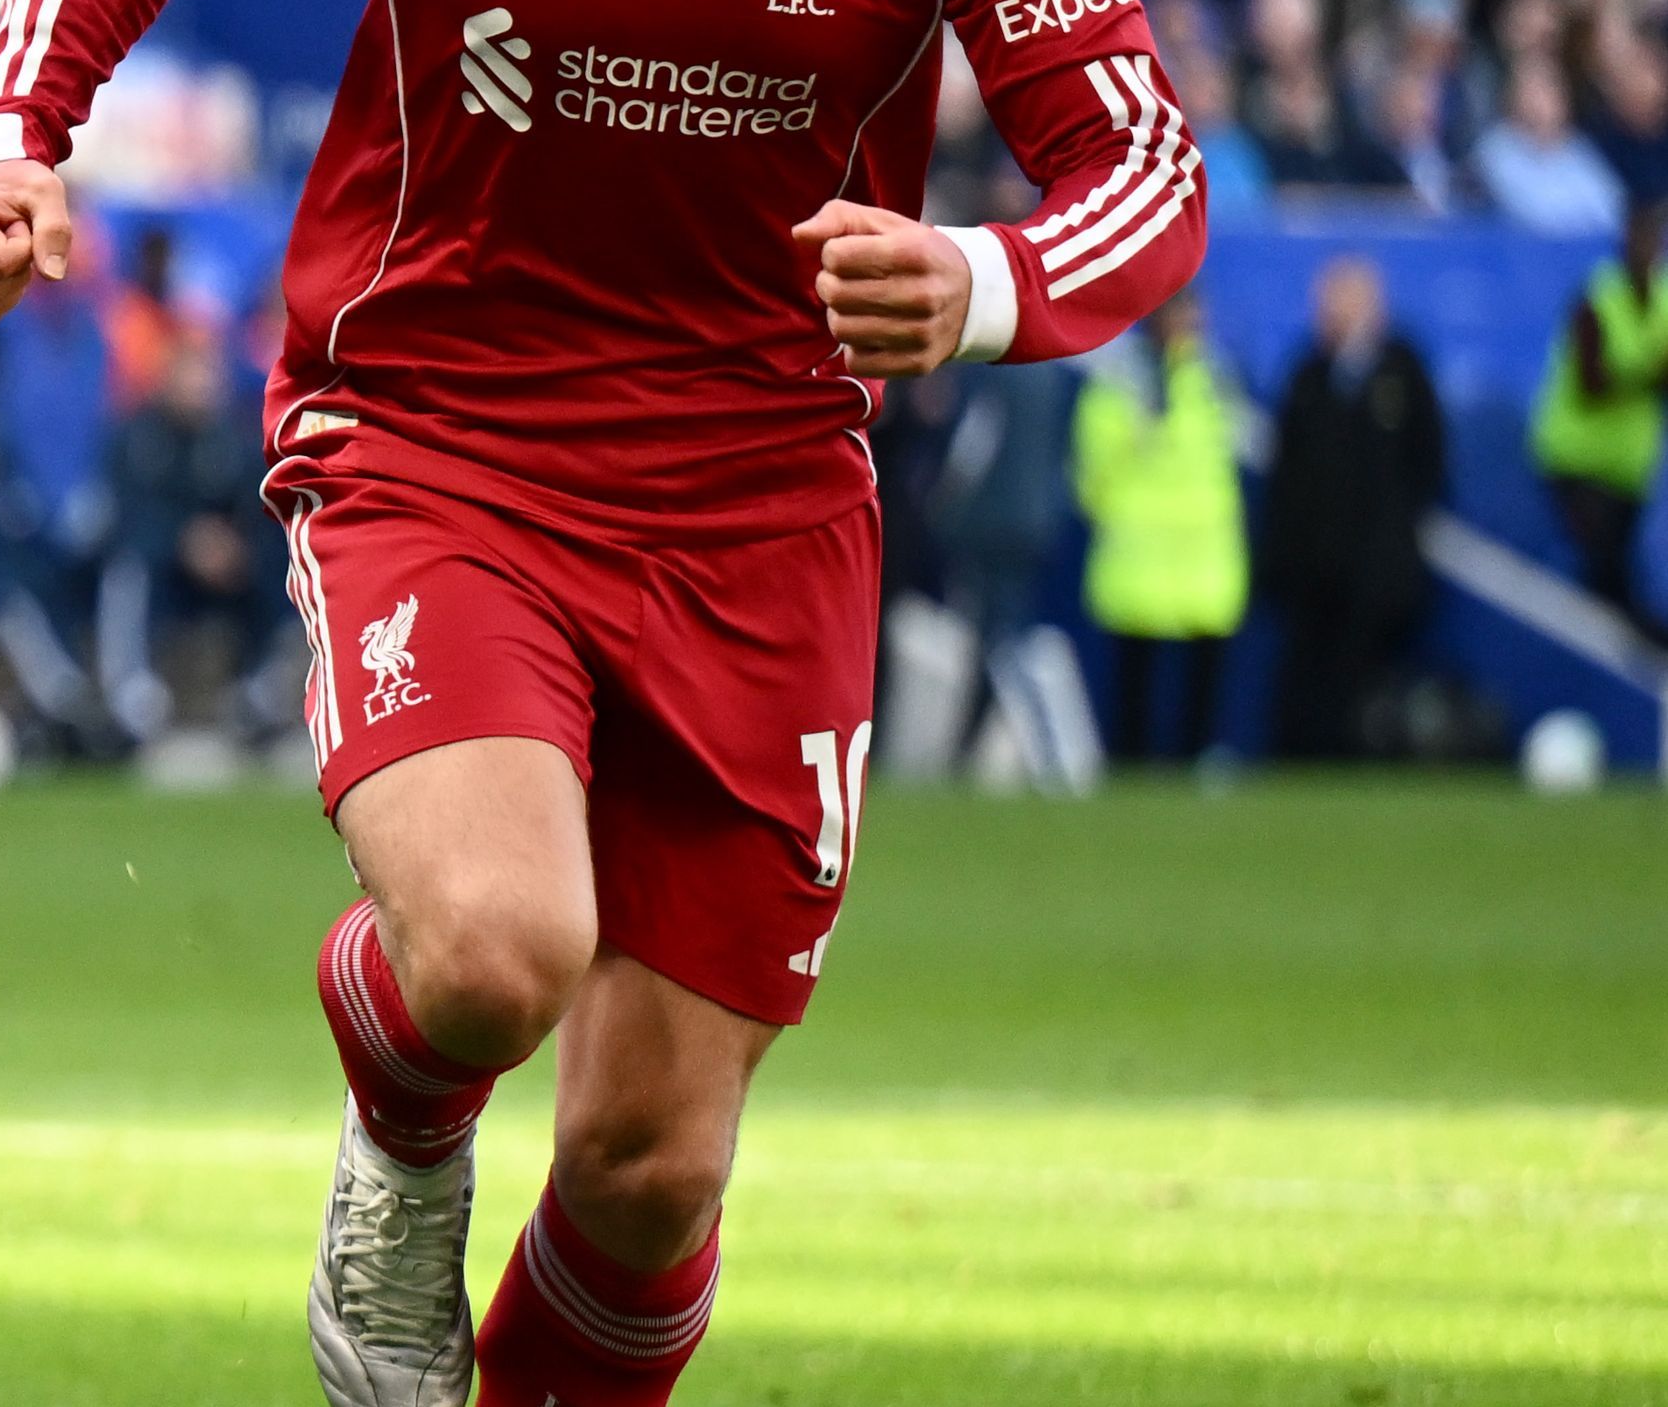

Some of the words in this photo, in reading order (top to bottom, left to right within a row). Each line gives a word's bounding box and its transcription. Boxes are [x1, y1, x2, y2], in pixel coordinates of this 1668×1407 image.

[557, 45, 817, 101] standard
[555, 87, 817, 138] chartered
[363, 682, 432, 726] L.F.C.
